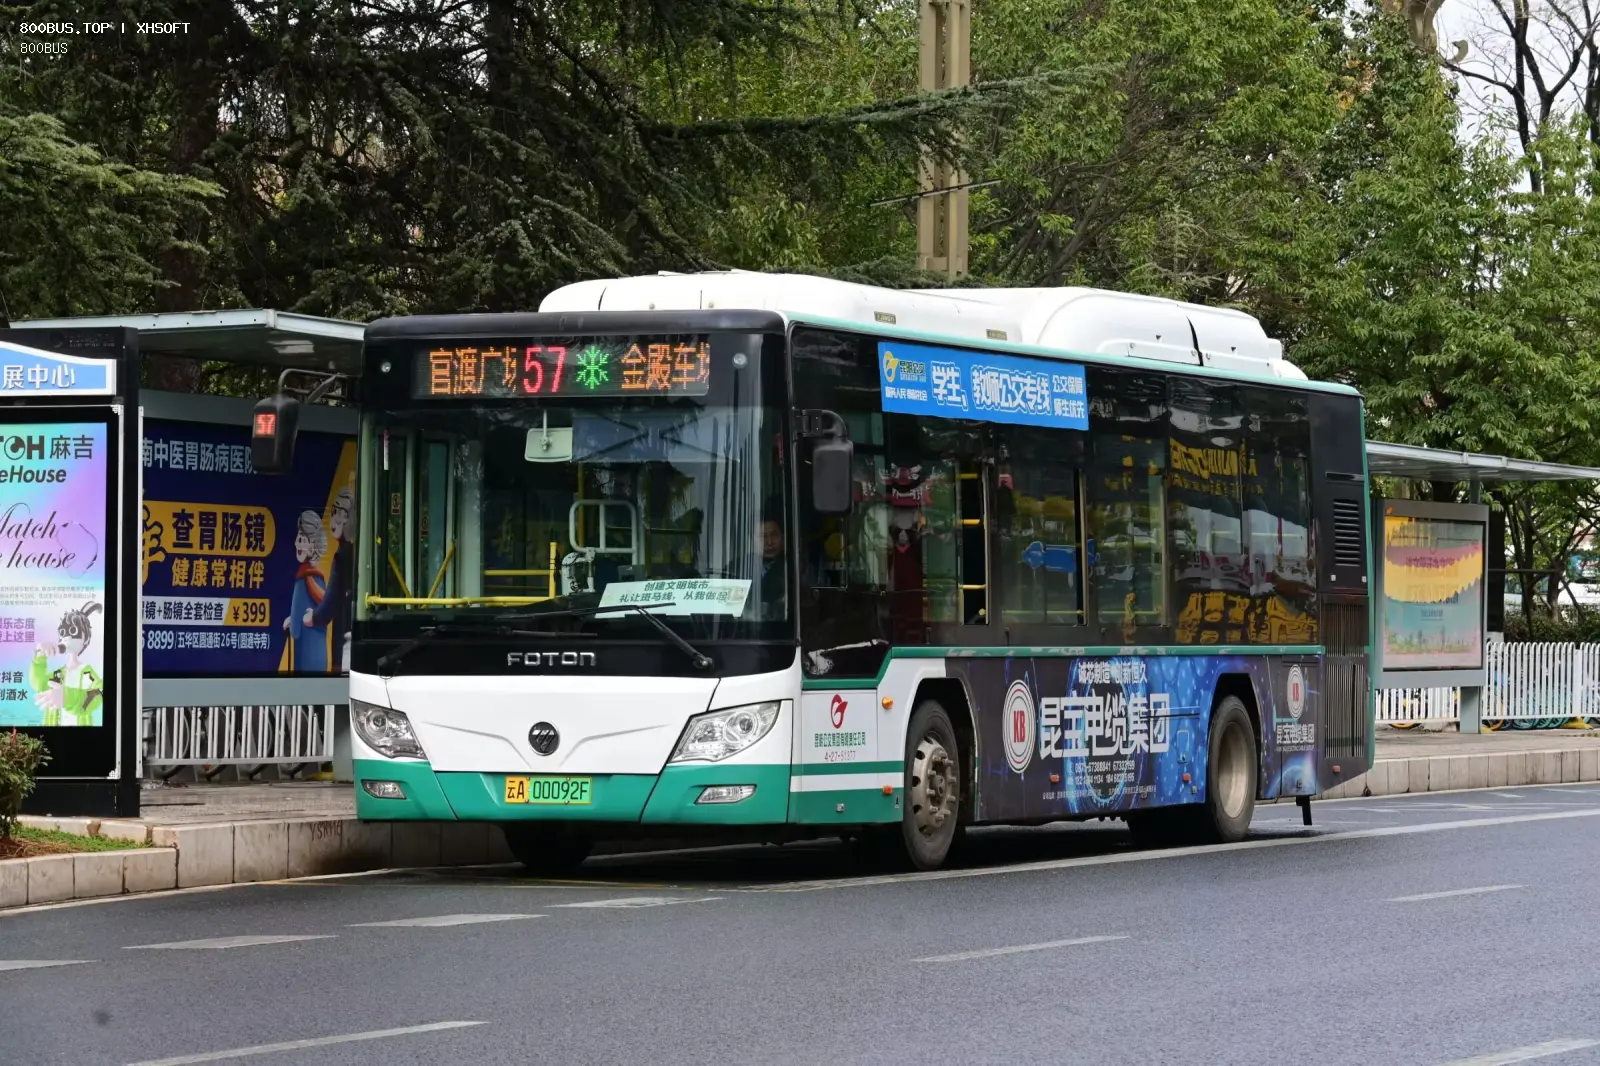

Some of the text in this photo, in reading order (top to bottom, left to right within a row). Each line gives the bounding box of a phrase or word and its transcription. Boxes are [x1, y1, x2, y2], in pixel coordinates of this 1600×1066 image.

[2, 364, 76, 390] 展中心
[523, 346, 566, 393] 57
[254, 414, 276, 436] 57
[50, 434, 95, 460] 麻吉
[172, 508, 265, 552] 查胃肠镜
[172, 557, 265, 589] 健康常相伴
[643, 580, 709, 592] 创建文明城市
[142, 600, 224, 621] 镜+肠镜全套检查
[507, 652, 597, 667] FOTON
[0, 671, 24, 684] 抖音
[1013, 710, 1026, 743] KB
[1041, 690, 1170, 759] 昆宝电缆集团
